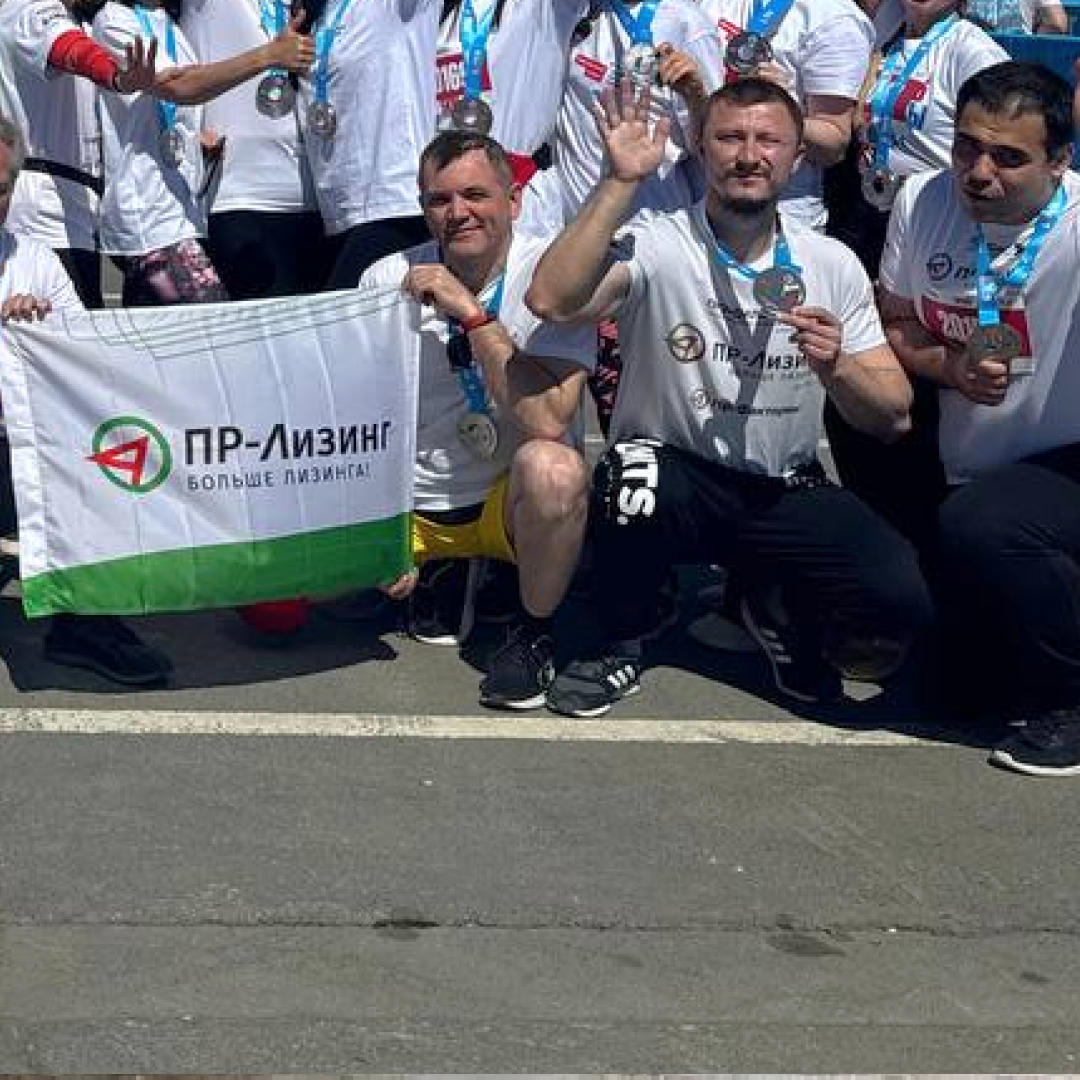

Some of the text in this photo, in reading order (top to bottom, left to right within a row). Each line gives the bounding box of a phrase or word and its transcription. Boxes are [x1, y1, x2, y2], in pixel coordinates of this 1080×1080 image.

[184, 421, 392, 465] ПР-Лизинг
[187, 462, 370, 491] БОЛЬШЕ ЛИЗИНГА!
